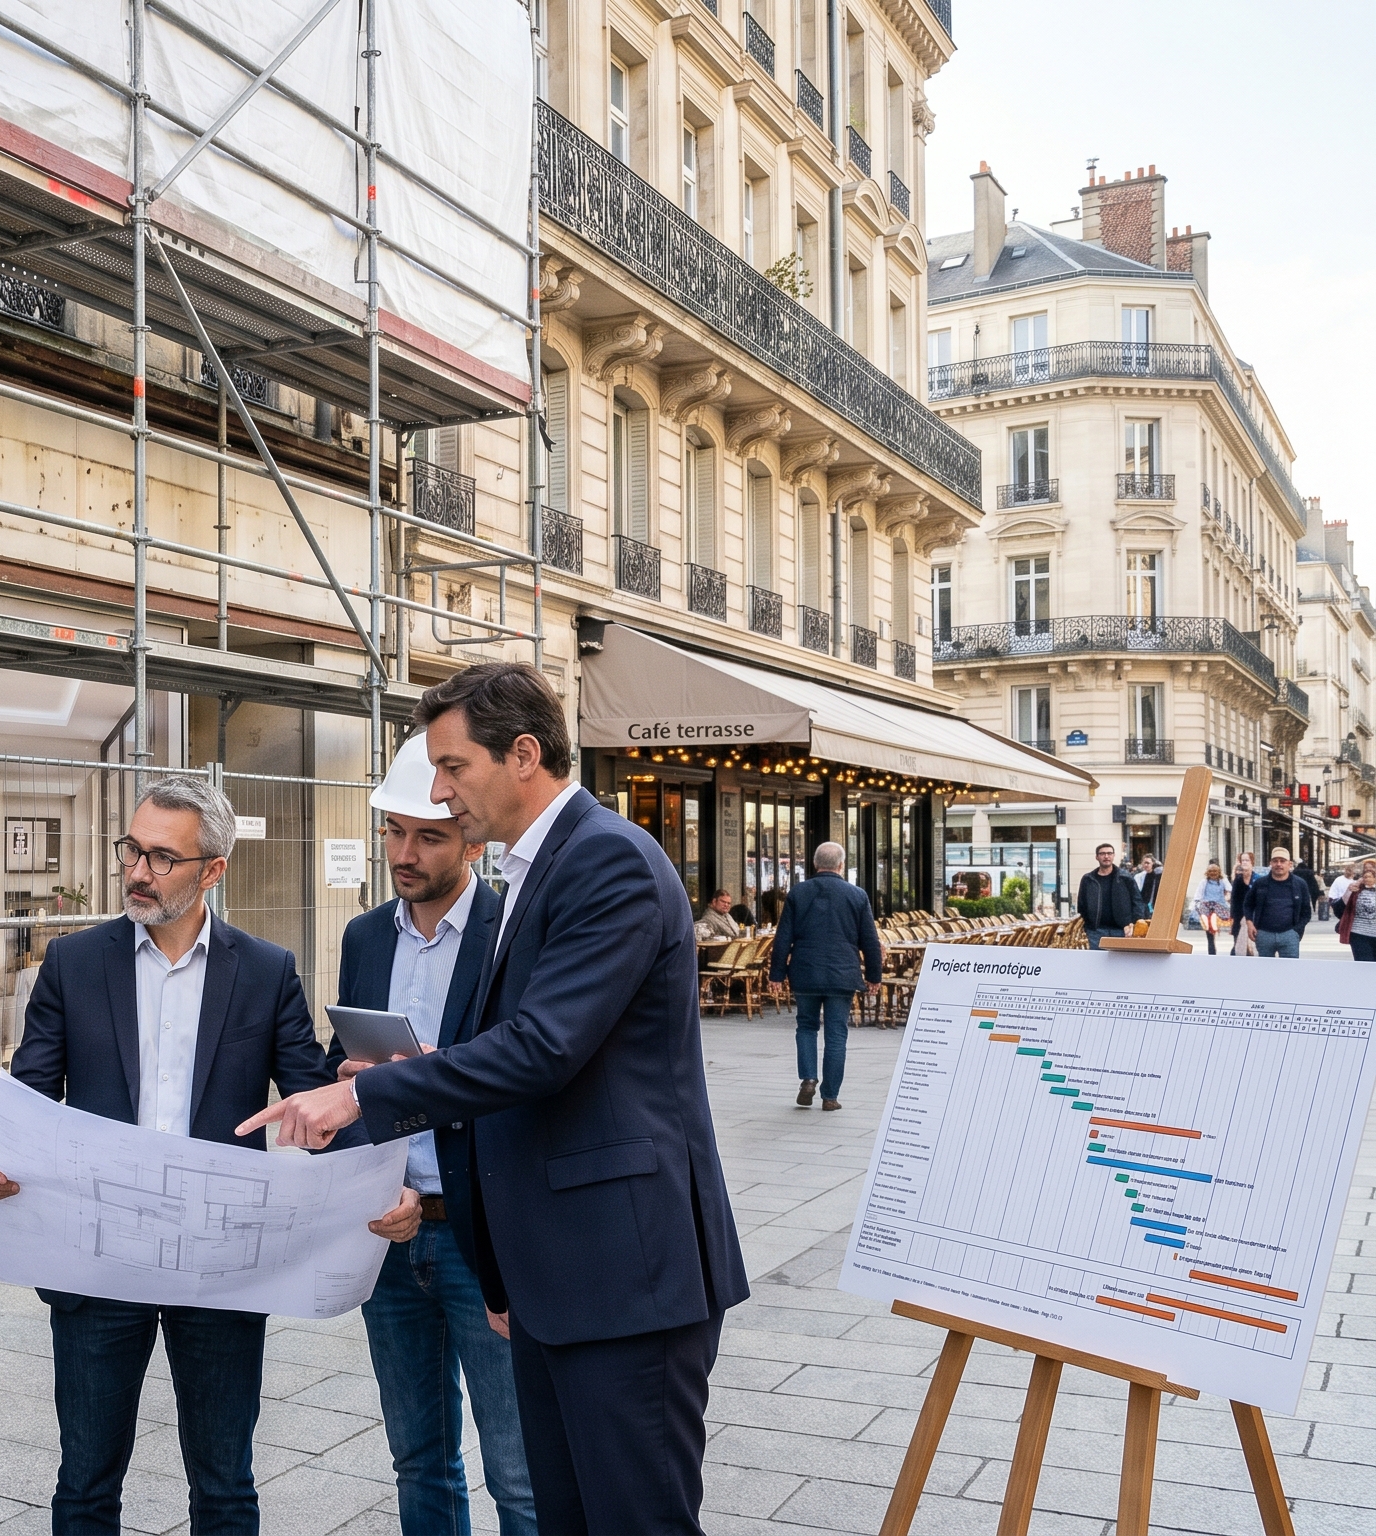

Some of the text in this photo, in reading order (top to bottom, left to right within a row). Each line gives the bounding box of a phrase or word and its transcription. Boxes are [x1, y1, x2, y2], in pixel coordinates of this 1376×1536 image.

[627, 721, 755, 740] Café terrasse
[931, 958, 972, 976] Project
